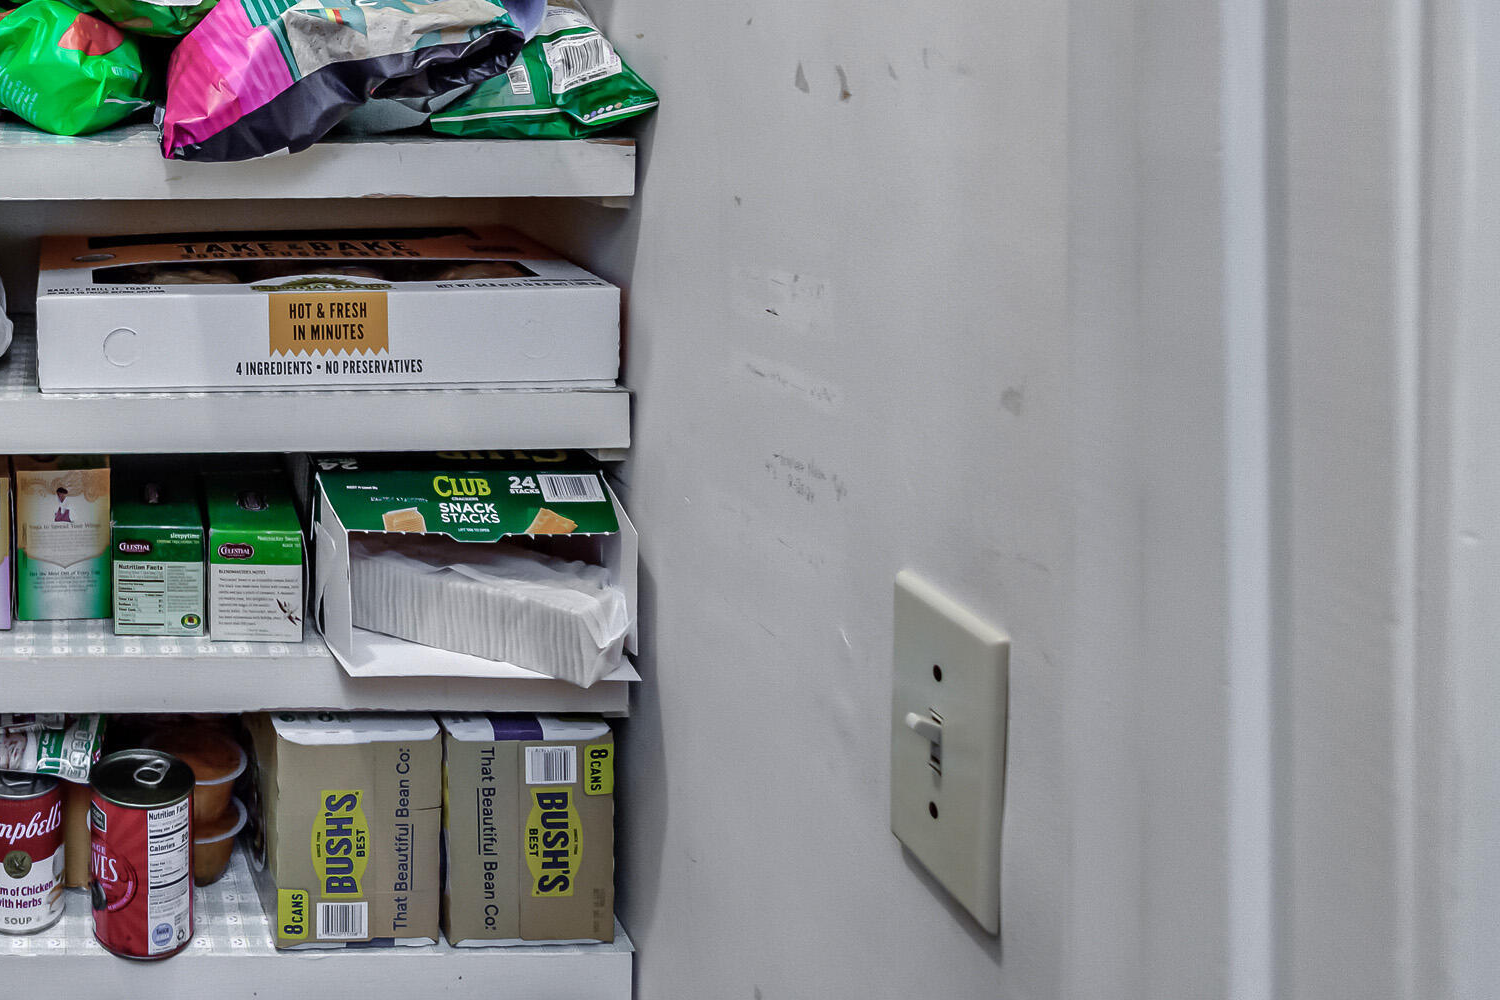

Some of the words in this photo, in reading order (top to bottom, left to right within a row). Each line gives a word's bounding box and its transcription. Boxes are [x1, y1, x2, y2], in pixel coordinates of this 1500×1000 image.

[181, 242, 272, 254] TAKE
[308, 240, 407, 252] BAKE
[289, 303, 312, 319] HOT
[316, 303, 325, 319] &
[330, 302, 367, 319] FRESH
[293, 325, 306, 341] IN
[310, 324, 364, 341] MINUTES
[235, 362, 242, 376] 4
[245, 361, 313, 376] INGREDIENTS
[325, 361, 339, 375] NO
[343, 359, 423, 375] PRESERVATIVES
[432, 475, 491, 497] CLUB
[508, 476, 536, 489] 24
[438, 502, 498, 514] SNACK
[441, 513, 501, 524] STACKS
[170, 532, 200, 541] sleepytime
[119, 543, 150, 552] CELESTIAL
[220, 546, 251, 555] CELESTIAL
[118, 564, 145, 572] Nutrition
[146, 564, 163, 572] Facts
[589, 748, 609, 760] 8
[481, 747, 496, 783] That
[589, 761, 602, 792] CANS
[395, 777, 410, 818] Bean
[149, 807, 175, 821] Nutrition
[177, 801, 189, 814] Facts
[480, 786, 497, 856] Beautiful
[149, 842, 175, 853] Calories
[324, 792, 358, 895] BUSH'S
[356, 828, 366, 858] BEST
[529, 828, 539, 858] BEST
[536, 792, 570, 895] BUSH'S
[393, 822, 409, 892] Beautiful
[11, 885, 20, 897] of
[21, 879, 54, 897] Chicken
[483, 860, 498, 901] Bean
[16, 897, 42, 909] Herbs
[292, 893, 304, 924] CANS
[4, 916, 32, 925] SOUP
[393, 896, 408, 931] That
[283, 924, 304, 936] 8
